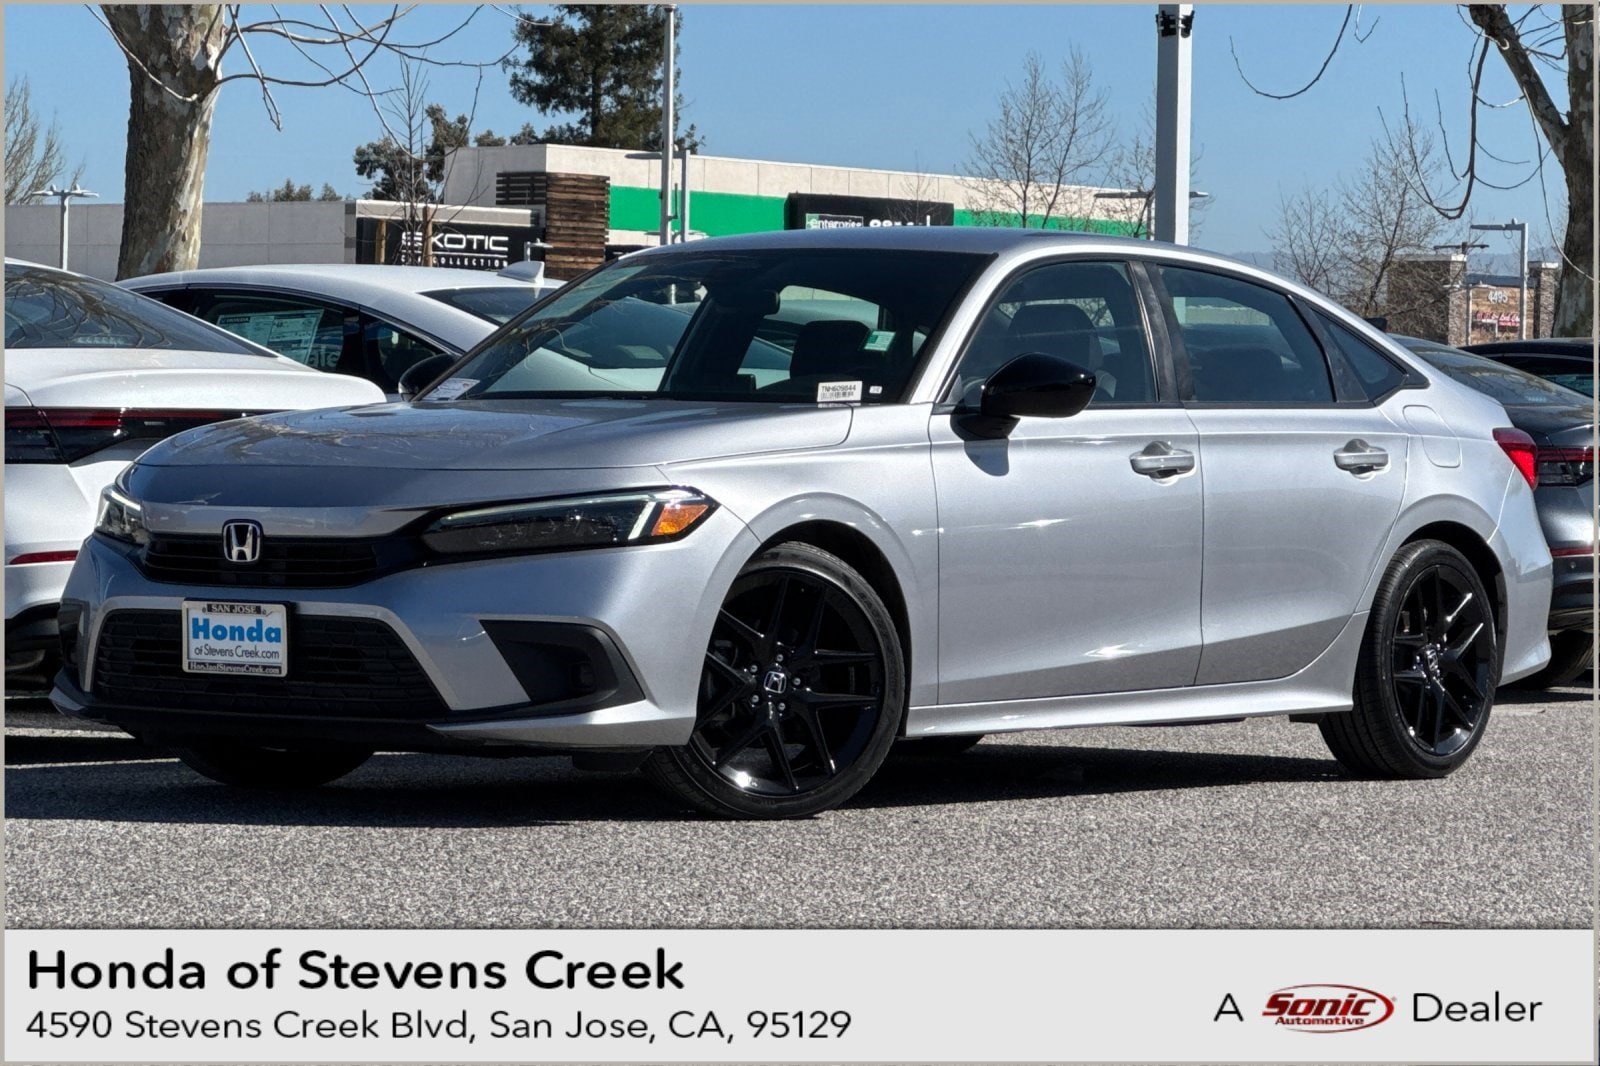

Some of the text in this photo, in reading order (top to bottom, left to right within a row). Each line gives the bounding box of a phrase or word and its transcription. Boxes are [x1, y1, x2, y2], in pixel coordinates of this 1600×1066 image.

[401, 231, 509, 251] EXOTIC
[432, 256, 508, 268] COLLECTION
[1488, 290, 1508, 303] 4495
[211, 604, 256, 614] SAN JOSE
[192, 617, 281, 642] Honda
[194, 643, 280, 660] of Stevens Creek.com
